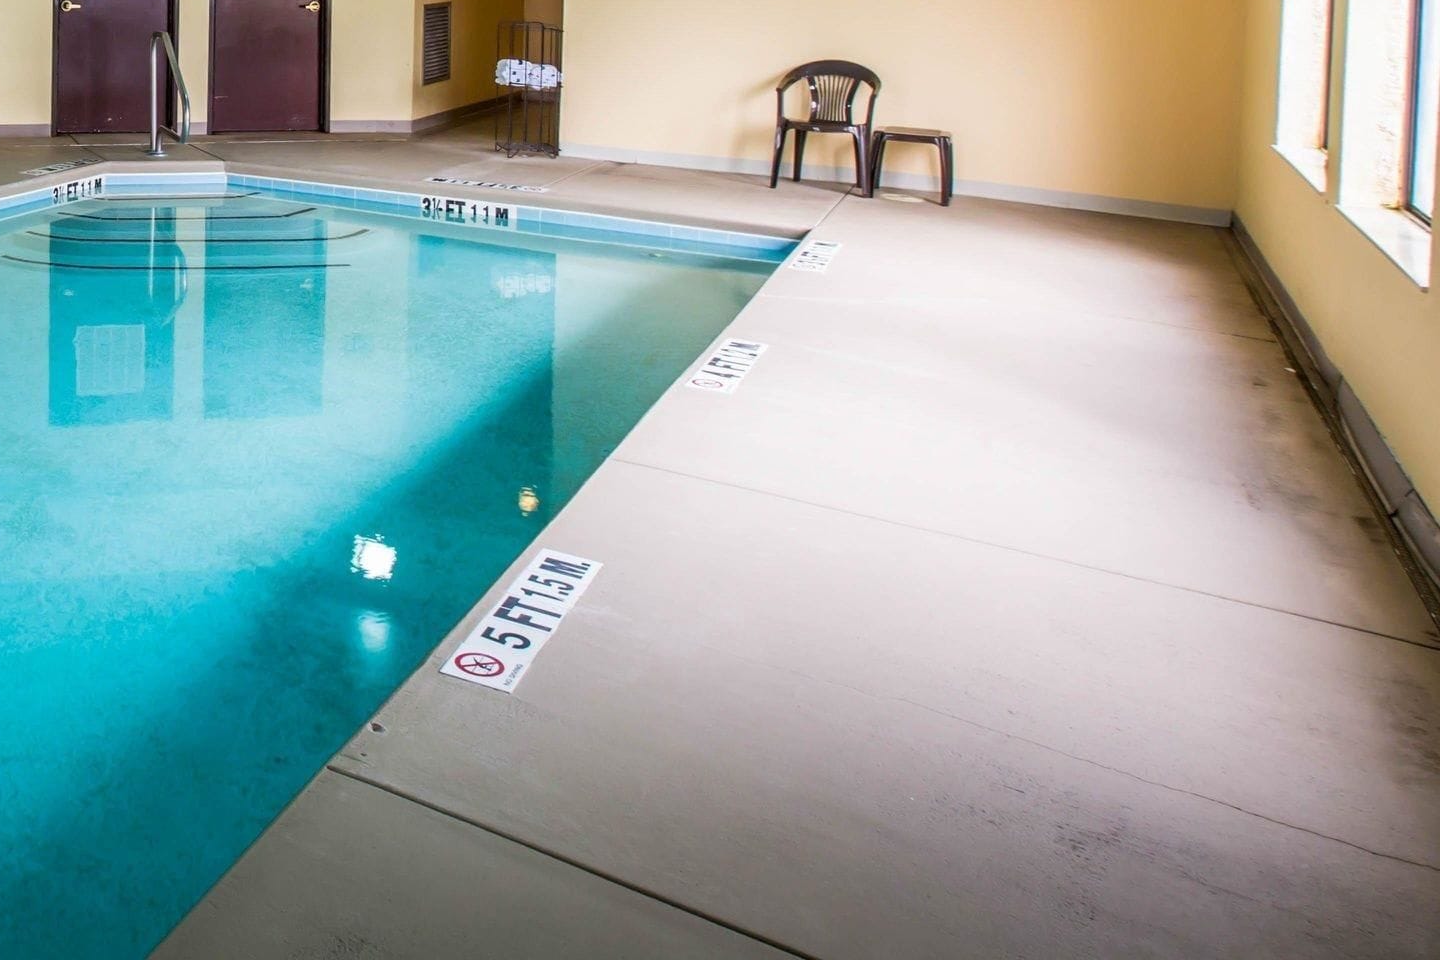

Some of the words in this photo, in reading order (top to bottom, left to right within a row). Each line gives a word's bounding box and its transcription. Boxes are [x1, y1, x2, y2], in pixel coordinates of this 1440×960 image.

[445, 199, 466, 215] FT
[520, 574, 575, 602] 1.5
[493, 596, 562, 632] FT
[480, 626, 531, 650] 5
